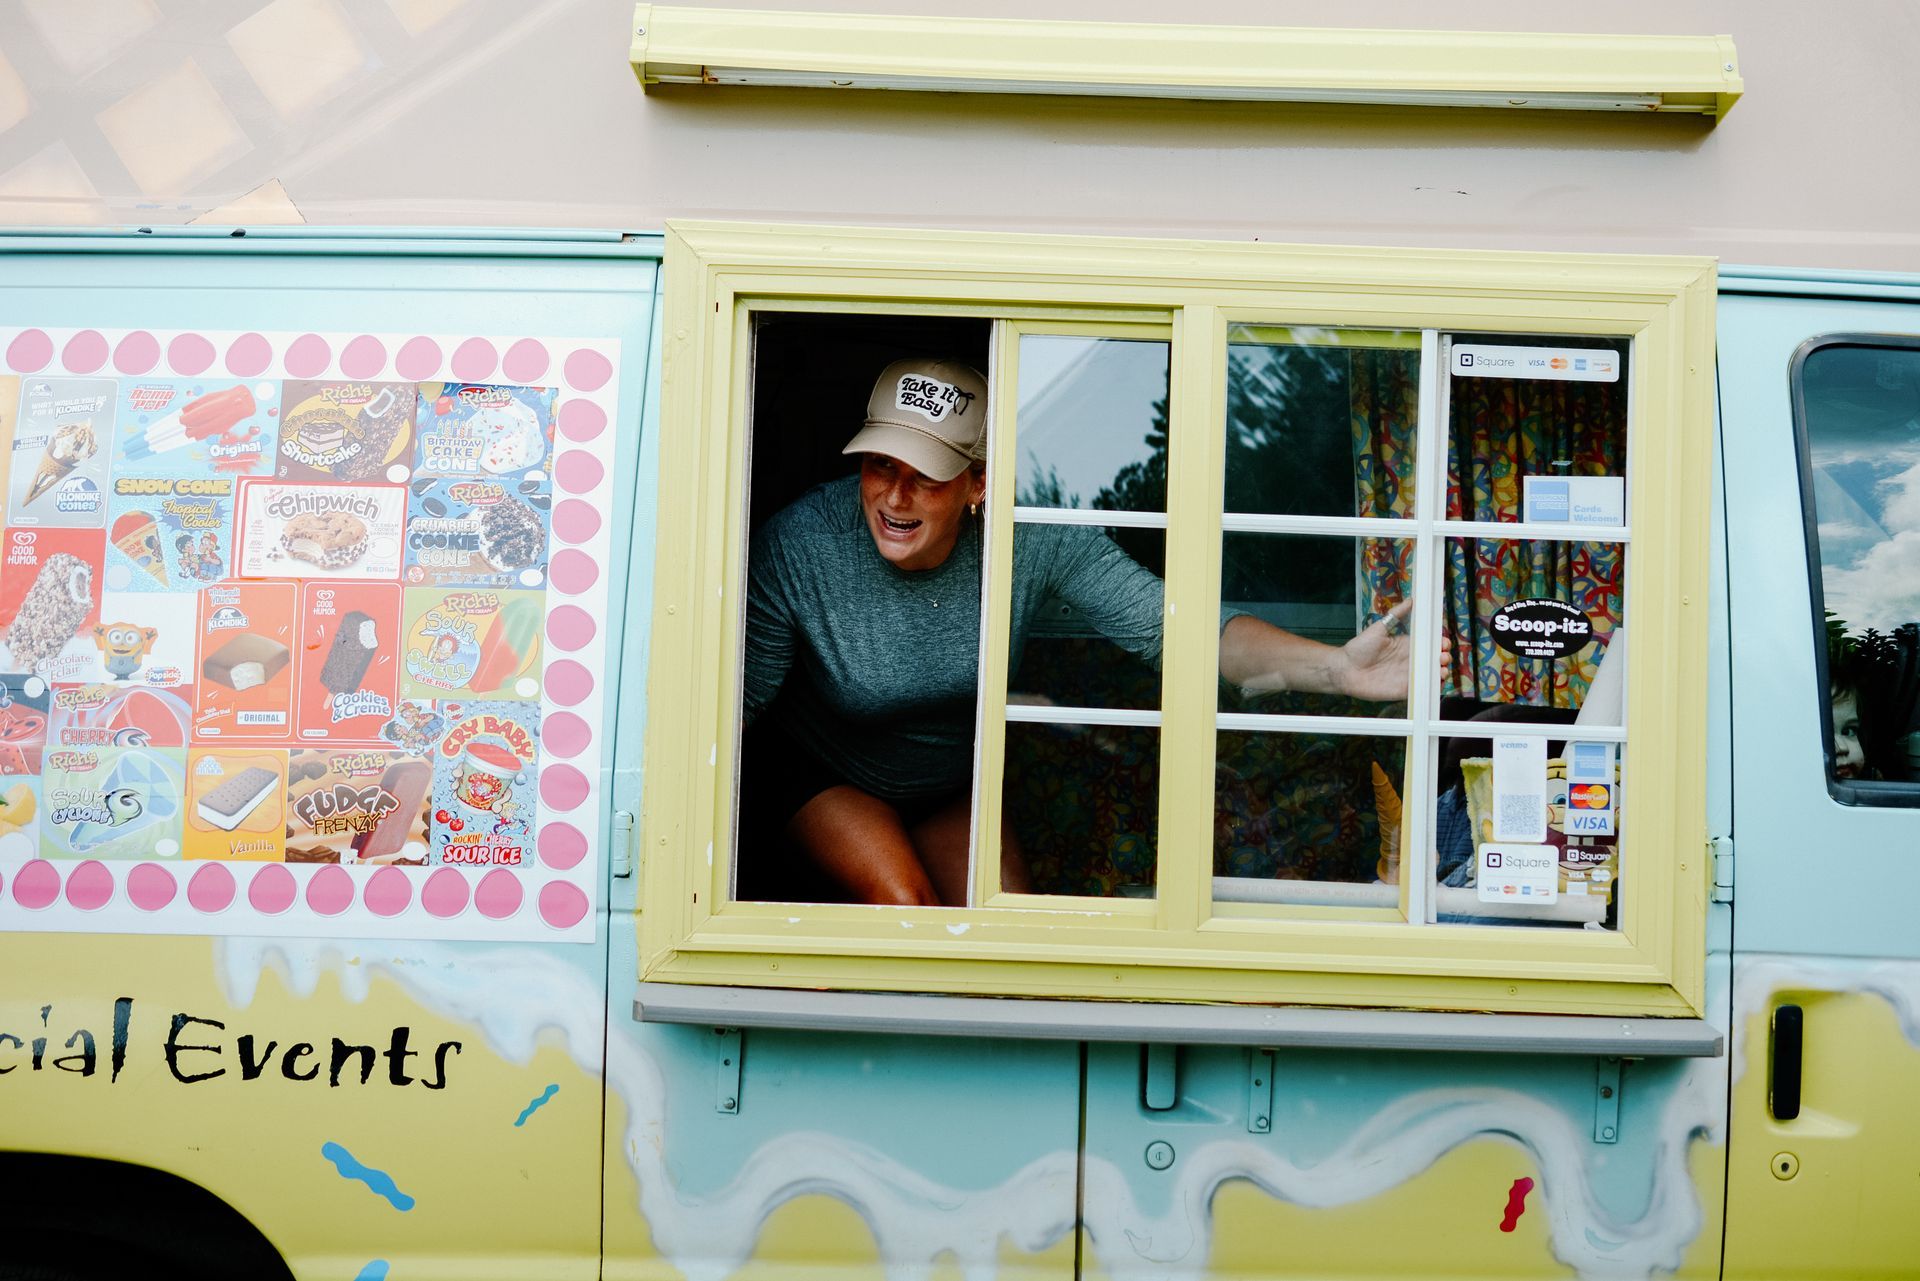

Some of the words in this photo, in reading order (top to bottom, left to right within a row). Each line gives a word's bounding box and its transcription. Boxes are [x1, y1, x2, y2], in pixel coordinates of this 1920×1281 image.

[1476, 355, 1515, 368] Square
[1528, 359, 1545, 367] VISA
[320, 384, 372, 406] Rich's
[460, 386, 512, 410] Rich's
[902, 378, 938, 399] Take
[940, 387, 955, 404] It
[901, 392, 944, 417] Easy
[209, 441, 263, 458] Original
[427, 438, 481, 448] BIRTHDAY
[280, 440, 362, 466] Shortcake
[432, 447, 473, 457] CAKE
[425, 457, 478, 471] CONE
[115, 479, 173, 496] SNOW
[174, 480, 231, 497] CONE
[452, 483, 503, 506] Rich's
[56, 492, 100, 506] KLONDIKE
[60, 501, 96, 511] cones
[268, 490, 379, 519] Chipwich
[163, 500, 217, 519] Tropical
[1573, 505, 1602, 513] Cards
[182, 515, 222, 528] Cooler
[411, 519, 480, 533] CRUMBLED
[1573, 514, 1618, 523] Welcome
[12, 546, 34, 555] GOOD
[409, 533, 480, 551] COOKIE
[8, 555, 38, 565] HUMOR
[418, 549, 470, 566] CONE
[313, 607, 336, 615] HUMOR
[446, 592, 499, 616] Rich's
[207, 618, 248, 633] KLONDIKE
[426, 610, 477, 644] SOUR
[1495, 614, 1588, 637] Scoop-itz
[37, 653, 93, 673] Chocolate
[406, 648, 472, 680] SWELL
[51, 664, 80, 681] Eclair
[414, 674, 455, 691] CHERRY
[58, 686, 105, 711] Rich's
[333, 691, 388, 708] Cookies
[244, 714, 280, 722] ORIGINAL
[332, 708, 342, 721] &
[344, 704, 390, 717] Creme
[60, 729, 117, 744] CHERRY
[442, 718, 479, 757] CRY
[484, 716, 534, 758] BABY
[52, 752, 98, 773] Rich's
[331, 753, 385, 779] Rich's
[51, 787, 107, 811] SOUR
[293, 784, 399, 828] FUDGE
[51, 808, 110, 825] CYCLONE
[313, 811, 381, 835] FRENZY
[1573, 817, 1608, 830] VISA
[229, 840, 276, 856] Vanilla
[453, 834, 482, 844] ROCKIN'
[485, 834, 513, 846] CHERRY
[443, 846, 490, 864] SOUR
[492, 846, 522, 864] ICE
[1505, 856, 1550, 869] Square
[1580, 852, 1611, 862] Square
[163, 1012, 462, 1089] Events
